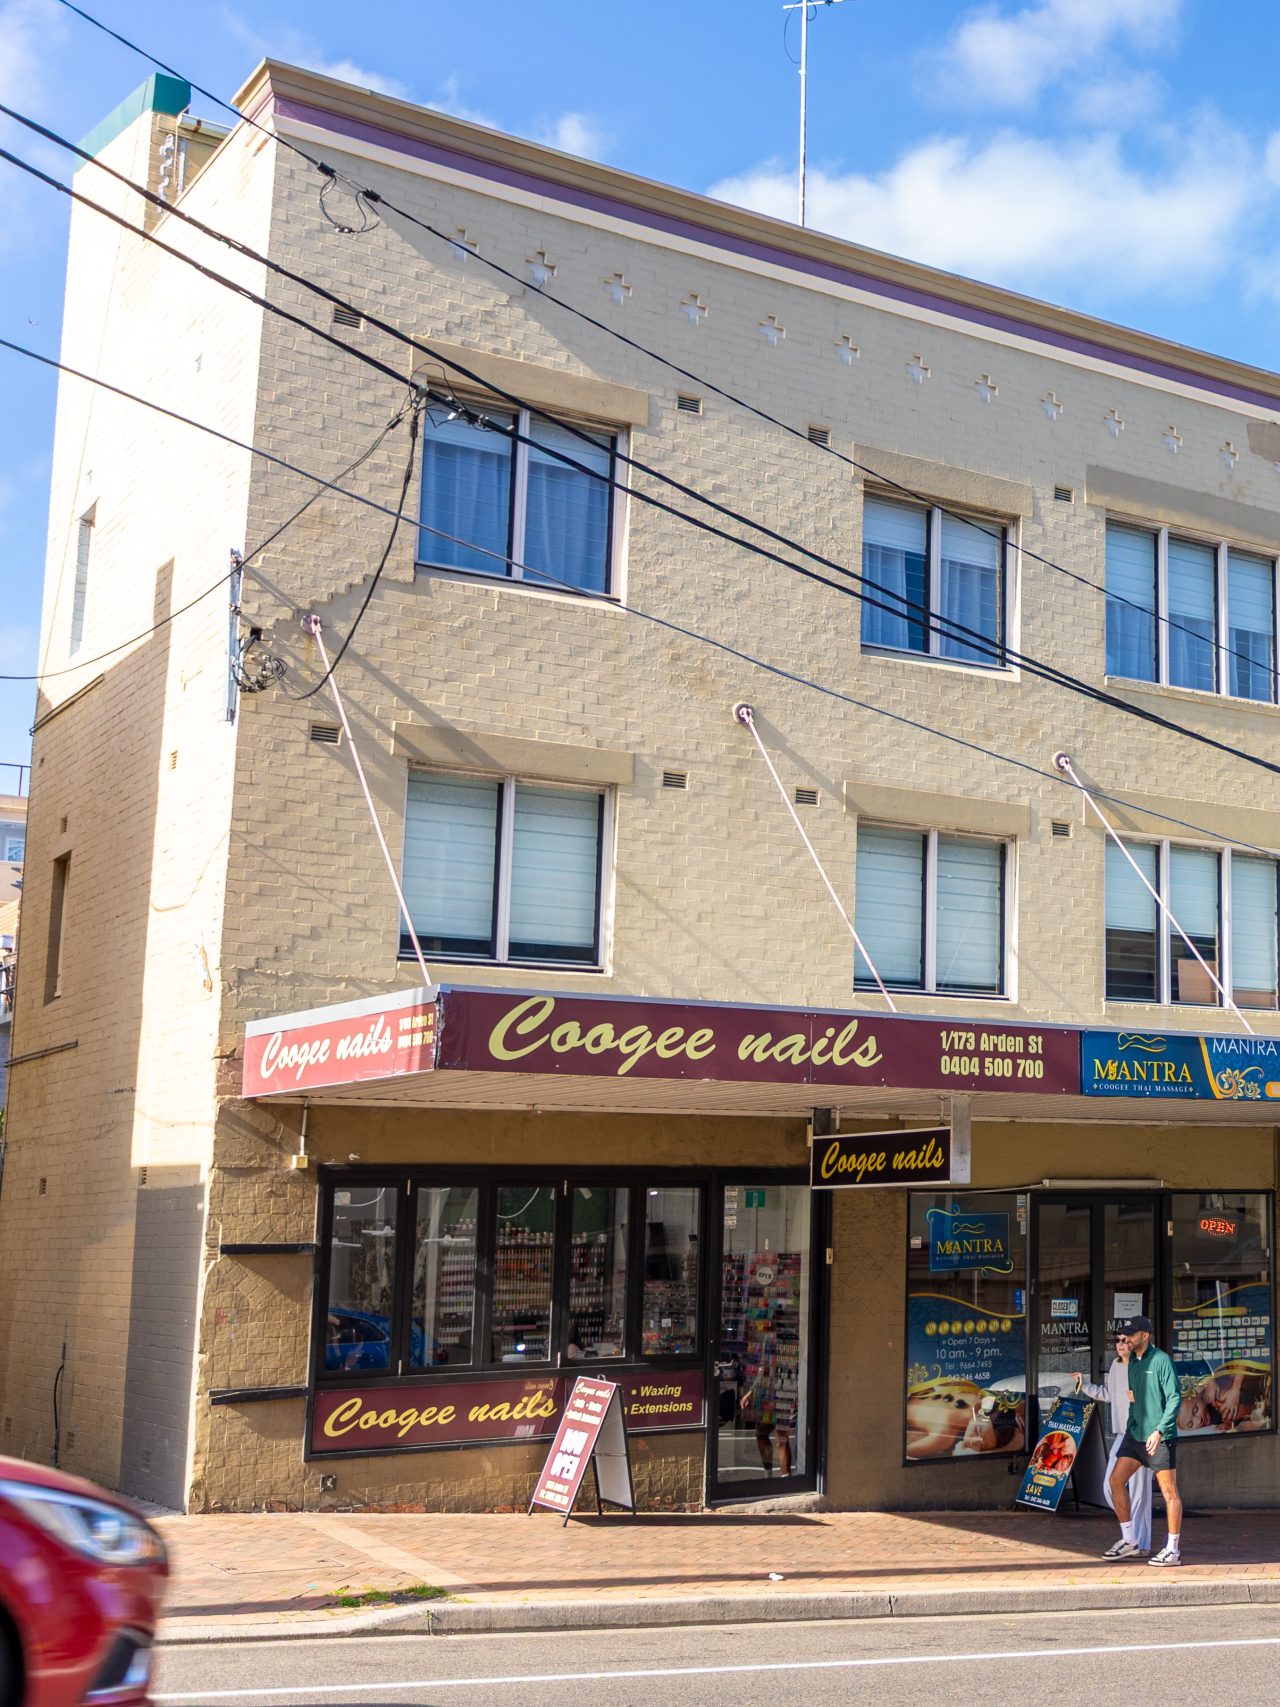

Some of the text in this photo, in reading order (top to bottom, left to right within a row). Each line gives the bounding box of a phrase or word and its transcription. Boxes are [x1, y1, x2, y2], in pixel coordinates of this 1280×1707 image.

[489, 995, 882, 1075] Coogee nails
[940, 1030, 1043, 1054] 1/173 Arden St
[260, 1014, 393, 1080] Coogee nails
[1212, 1038, 1277, 1057] MANTRA
[940, 1055, 1044, 1078] 0404 500 700
[1093, 1058, 1193, 1083] MANTRA
[1098, 1084, 1129, 1092] COOGEE
[1155, 1085, 1189, 1093] MASSAGE
[821, 1138, 945, 1183] Coogee nails
[1200, 1219, 1236, 1234] OPEN
[937, 1239, 1004, 1255] MANTRA
[758, 1272, 772, 1280] OPEN
[1041, 1321, 1089, 1335] MANTRA
[947, 1337, 968, 1347] Open
[974, 1336, 991, 1346] Days
[935, 1349, 947, 1360] 10
[976, 1347, 982, 1357] 9
[640, 1384, 682, 1397] Waxing
[324, 1397, 456, 1438] Coogee
[468, 1390, 557, 1420] nails
[630, 1401, 693, 1415] Extensions
[1047, 1420, 1081, 1434] THAI MASSAGE
[550, 1452, 581, 1481] OPEN
